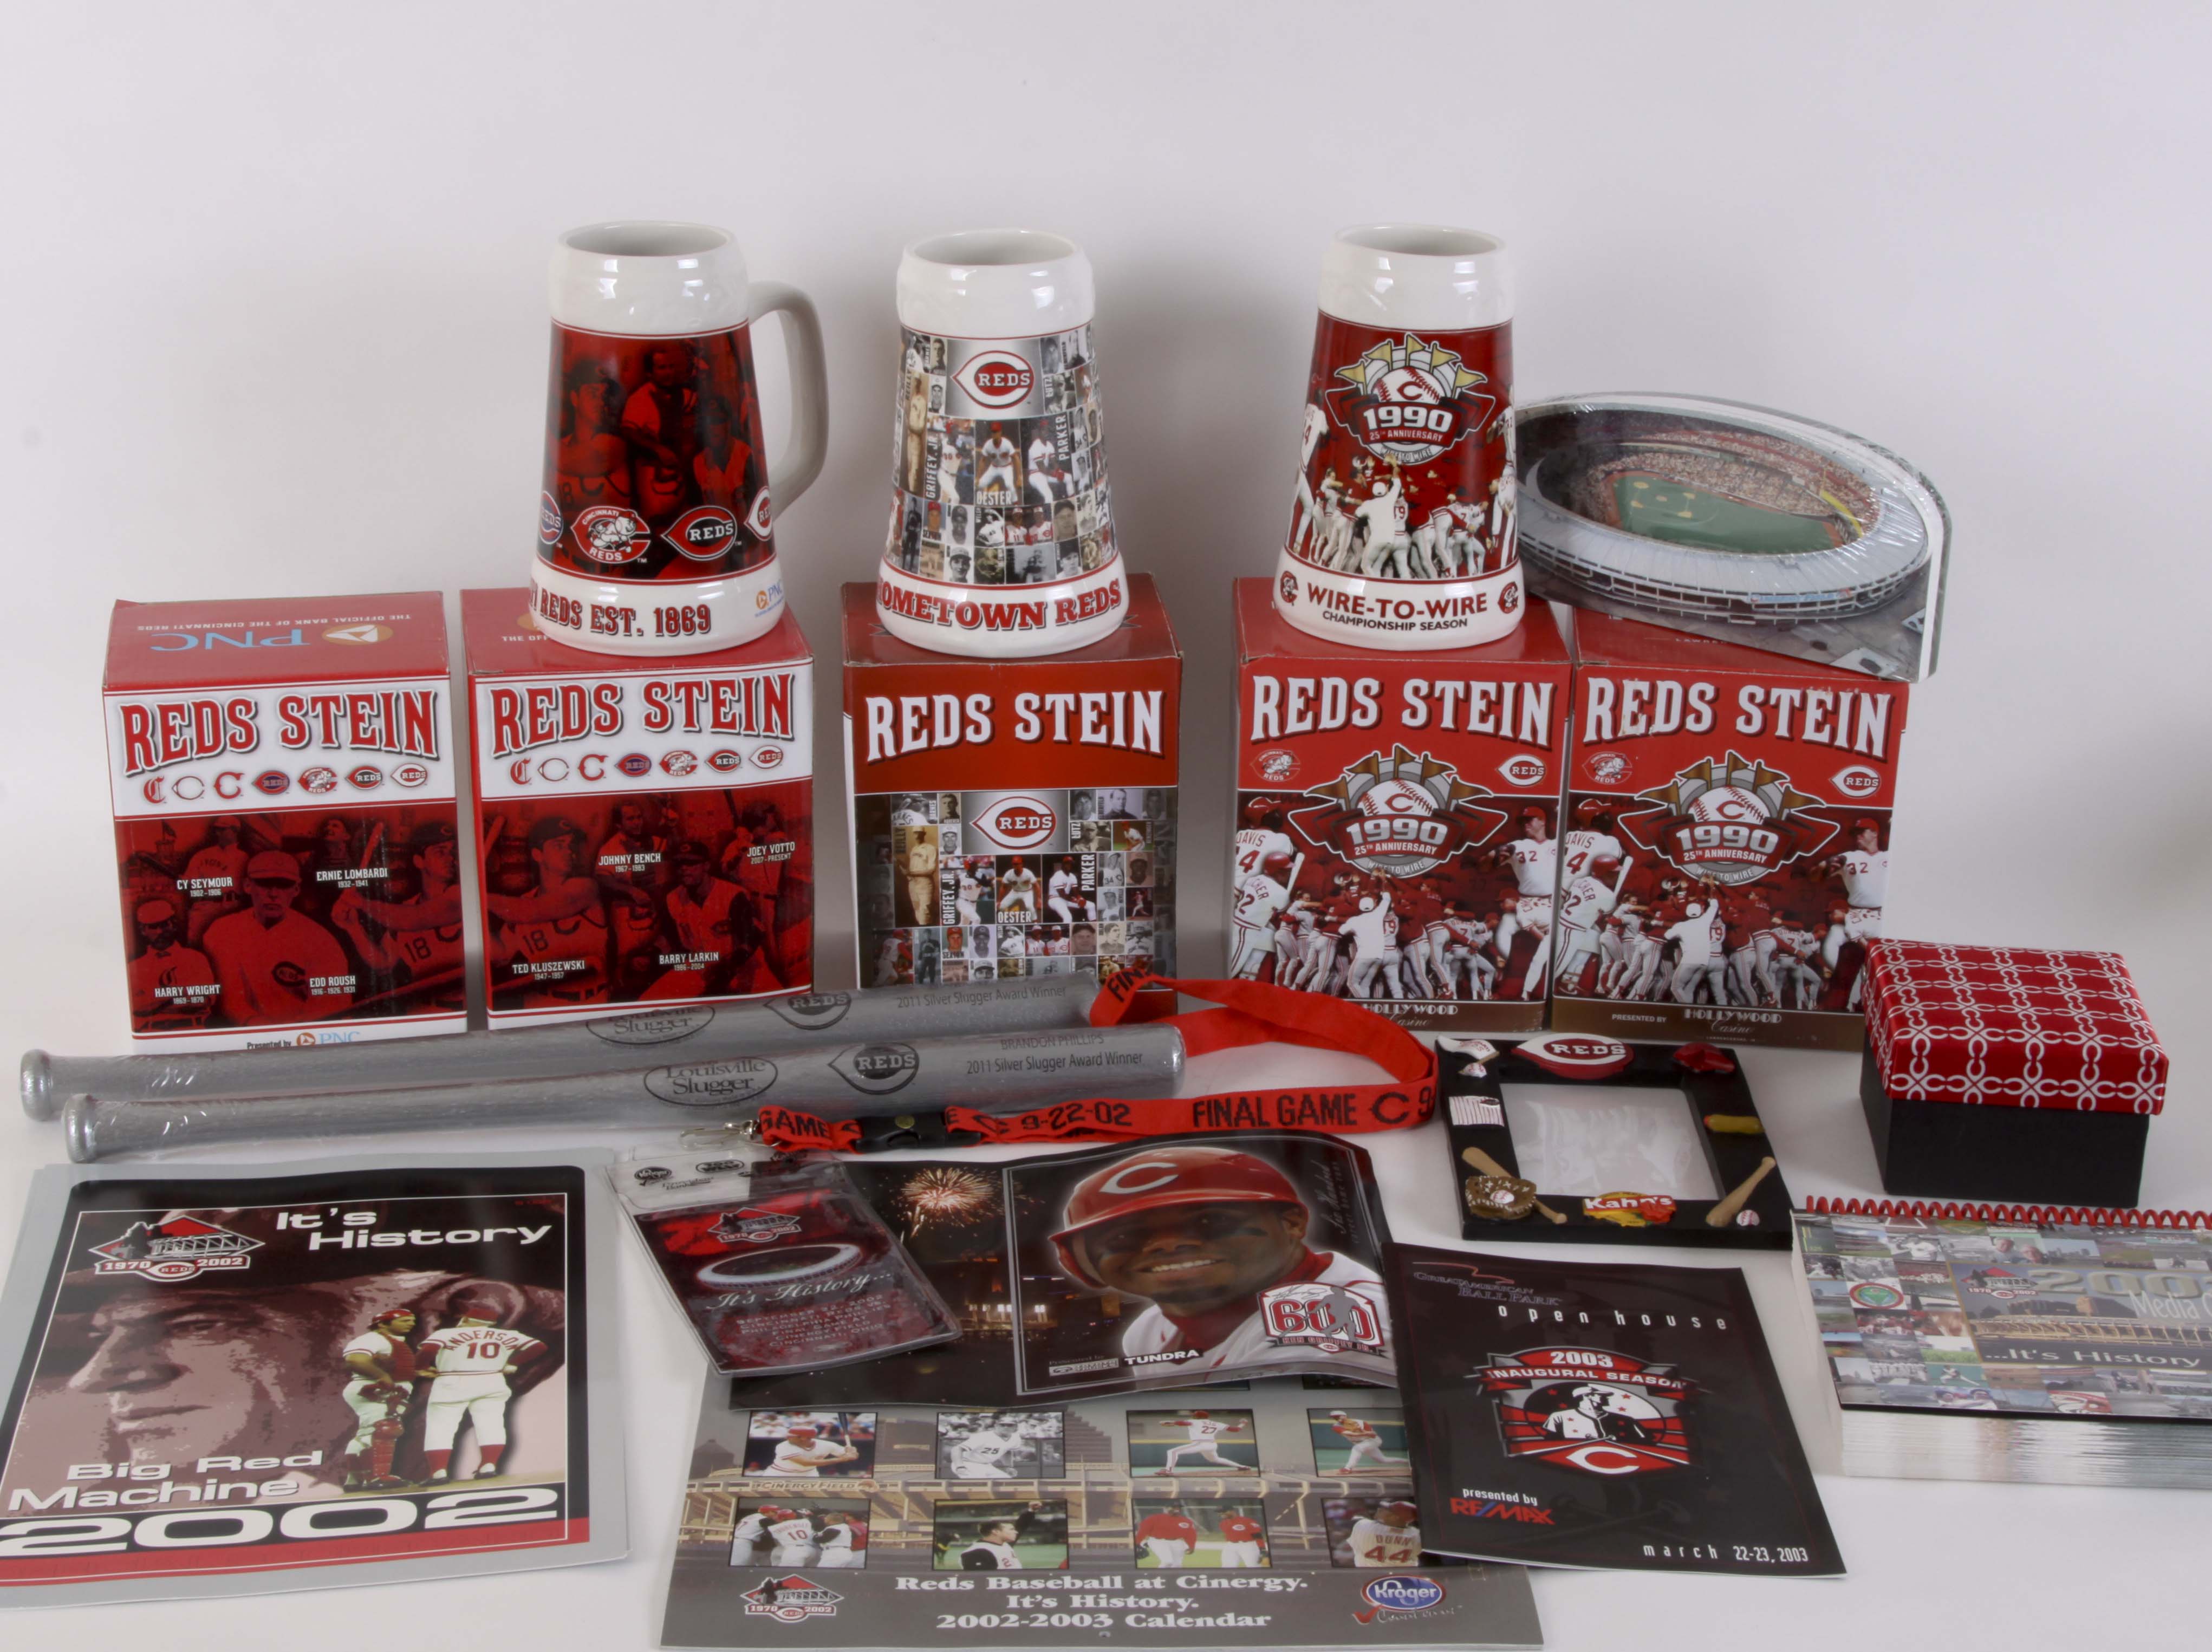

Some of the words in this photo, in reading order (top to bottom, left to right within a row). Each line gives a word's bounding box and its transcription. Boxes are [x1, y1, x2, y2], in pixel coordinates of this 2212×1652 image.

[978, 372, 1031, 386] REDS
[1362, 406, 1454, 433] 1990
[1056, 414, 1069, 461] PARKER
[1387, 430, 1443, 442] ANNIVERSARY
[1413, 447, 1433, 460] WIRE
[976, 490, 1012, 505] OESTER
[582, 509, 619, 525] CINCINNATI
[689, 522, 734, 542] REDS
[589, 547, 622, 562] REDS
[1054, 577, 1122, 625] REDS
[1307, 582, 1488, 620] WIRE-TO-WIRE
[541, 588, 582, 629] REDS
[590, 604, 643, 637] EST.
[654, 603, 711, 637] 1869
[1322, 610, 1416, 631] CHAMPIONSHIP
[1420, 618, 1468, 631] SEASON
[149, 628, 311, 652] PNC
[489, 682, 623, 759] REDS
[642, 672, 795, 741] STEIN
[1250, 675, 1384, 744] REDS
[1401, 677, 1558, 752] STEIN
[1583, 677, 1716, 746] REDS
[1735, 684, 1896, 764] STEIN
[118, 697, 258, 778] REDS
[278, 690, 440, 761] STEIN
[865, 693, 996, 766] REDS
[1014, 691, 1167, 759] STEIN
[715, 757, 740, 766] REDS
[758, 752, 783, 762] REDS
[356, 773, 382, 783] REDS
[401, 770, 427, 780] REDS
[1264, 773, 1284, 782] REDS
[1511, 766, 1545, 776] REDS
[1595, 776, 1616, 784] REDS
[1845, 777, 1879, 787] REDS
[999, 815, 1053, 830] REDS
[1071, 821, 1082, 840] LUTZ
[1345, 818, 1449, 846] 1990
[1676, 824, 1779, 853] 1990
[747, 845, 768, 857] JOEY
[770, 842, 796, 855] VOTTO
[1375, 842, 1438, 856] ANNIVERSARY
[1704, 849, 1768, 863] ANNIVERSARY
[598, 855, 628, 866] JOHNNY
[630, 853, 661, 864] BENCH
[316, 869, 342, 882] ERNIE
[344, 867, 388, 880] LOMBARDI
[1081, 853, 1095, 892] PARKER
[176, 878, 189, 890] CY
[191, 876, 233, 889] SEYMOUR
[998, 911, 1032, 923] OESTER
[512, 964, 530, 974] TED
[530, 960, 585, 973] KLUSZEWSKI
[659, 954, 687, 965] BARRY
[688, 952, 719, 963] LARKIN
[309, 977, 326, 988] EDD
[327, 975, 356, 987] ROUSH
[154, 986, 183, 998] HARRY
[186, 984, 221, 996] WRIGHT
[792, 992, 848, 1008] REDS
[896, 997, 922, 1009] 2011
[923, 993, 952, 1006] Silver
[953, 991, 993, 1007] Slugger
[995, 987, 1029, 1001] Award
[1031, 985, 1066, 998] Winner
[1362, 1004, 1459, 1015] HOLLYWOOD
[1611, 1013, 1654, 1023] PRESENTED
[1684, 1009, 1782, 1023] HOLLYWOOD
[613, 1016, 693, 1035] Slugger
[246, 1040, 282, 1050] Presented
[1000, 1035, 1056, 1050] BRANDON
[1057, 1033, 1104, 1046] PHILLIPS
[1552, 1043, 1626, 1056] REDS
[666, 1059, 766, 1079] Louisville
[857, 1053, 916, 1070] REDS
[966, 1059, 992, 1074] 2011
[993, 1058, 1024, 1073] Silver
[1025, 1054, 1067, 1072] Slugger
[1069, 1053, 1104, 1068] Award
[1104, 1052, 1143, 1065] Winner
[673, 1077, 754, 1097] Slugger
[1021, 1101, 1133, 1131] 9-22-02
[1193, 1096, 1271, 1128] FINAL
[1277, 1093, 1357, 1127] GAME
[760, 1109, 831, 1139] GAME
[1584, 1195, 1673, 1210] Kahn's
[276, 1207, 378, 1232] It's
[307, 1221, 554, 1253] History
[104, 1259, 151, 1272] 1970
[160, 1264, 196, 1275] REDS
[196, 1256, 244, 1269] 2002
[1458, 1285, 1508, 1301] BALL
[1508, 1292, 1560, 1306] PARK
[1967, 1286, 1992, 1295] 1970
[706, 1290, 755, 1310] It's
[2128, 1288, 2201, 1321] Media
[1269, 1298, 1375, 1341] 600
[1498, 1305, 1589, 1324] open
[1614, 1310, 1727, 1331] house
[444, 1330, 521, 1351] ANDERSON
[465, 1341, 501, 1361] 10
[1124, 1349, 1200, 1365] TUNDRA
[1550, 1351, 1615, 1369] 2003
[2073, 1350, 2201, 1368] History
[1486, 1368, 1599, 1381] INAUGURAL
[1605, 1372, 1688, 1390] SEASON
[67, 1461, 171, 1483] Big
[197, 1449, 323, 1472] Red
[762, 1481, 817, 1489] CINERGY
[818, 1481, 855, 1489] FIELD
[8, 1479, 300, 1512] Machine
[1462, 1487, 1520, 1504] presented
[1523, 1493, 1538, 1507] by
[1449, 1497, 1556, 1526] RE/MAX
[0, 1486, 558, 1558] 2002
[787, 1528, 808, 1542] 10
[1375, 1534, 1413, 1546] DUNN
[1364, 1545, 1413, 1564] 44
[1643, 1544, 1717, 1560] march
[1733, 1545, 1776, 1564] 22-23,
[1777, 1546, 1808, 1563] 2003
[895, 1576, 975, 1591] Reds
[986, 1575, 1131, 1591] Baseball
[1134, 1576, 1167, 1590] at
[1175, 1575, 1309, 1595] Cinergy.
[1374, 1579, 1439, 1607] Kroger
[750, 1604, 778, 1614] 1970
[805, 1605, 833, 1614] 2002
[1006, 1594, 1058, 1609] It's
[1070, 1593, 1199, 1612] History.
[936, 1612, 1112, 1630] 2002-2003
[1124, 1611, 1272, 1629] Calendar
